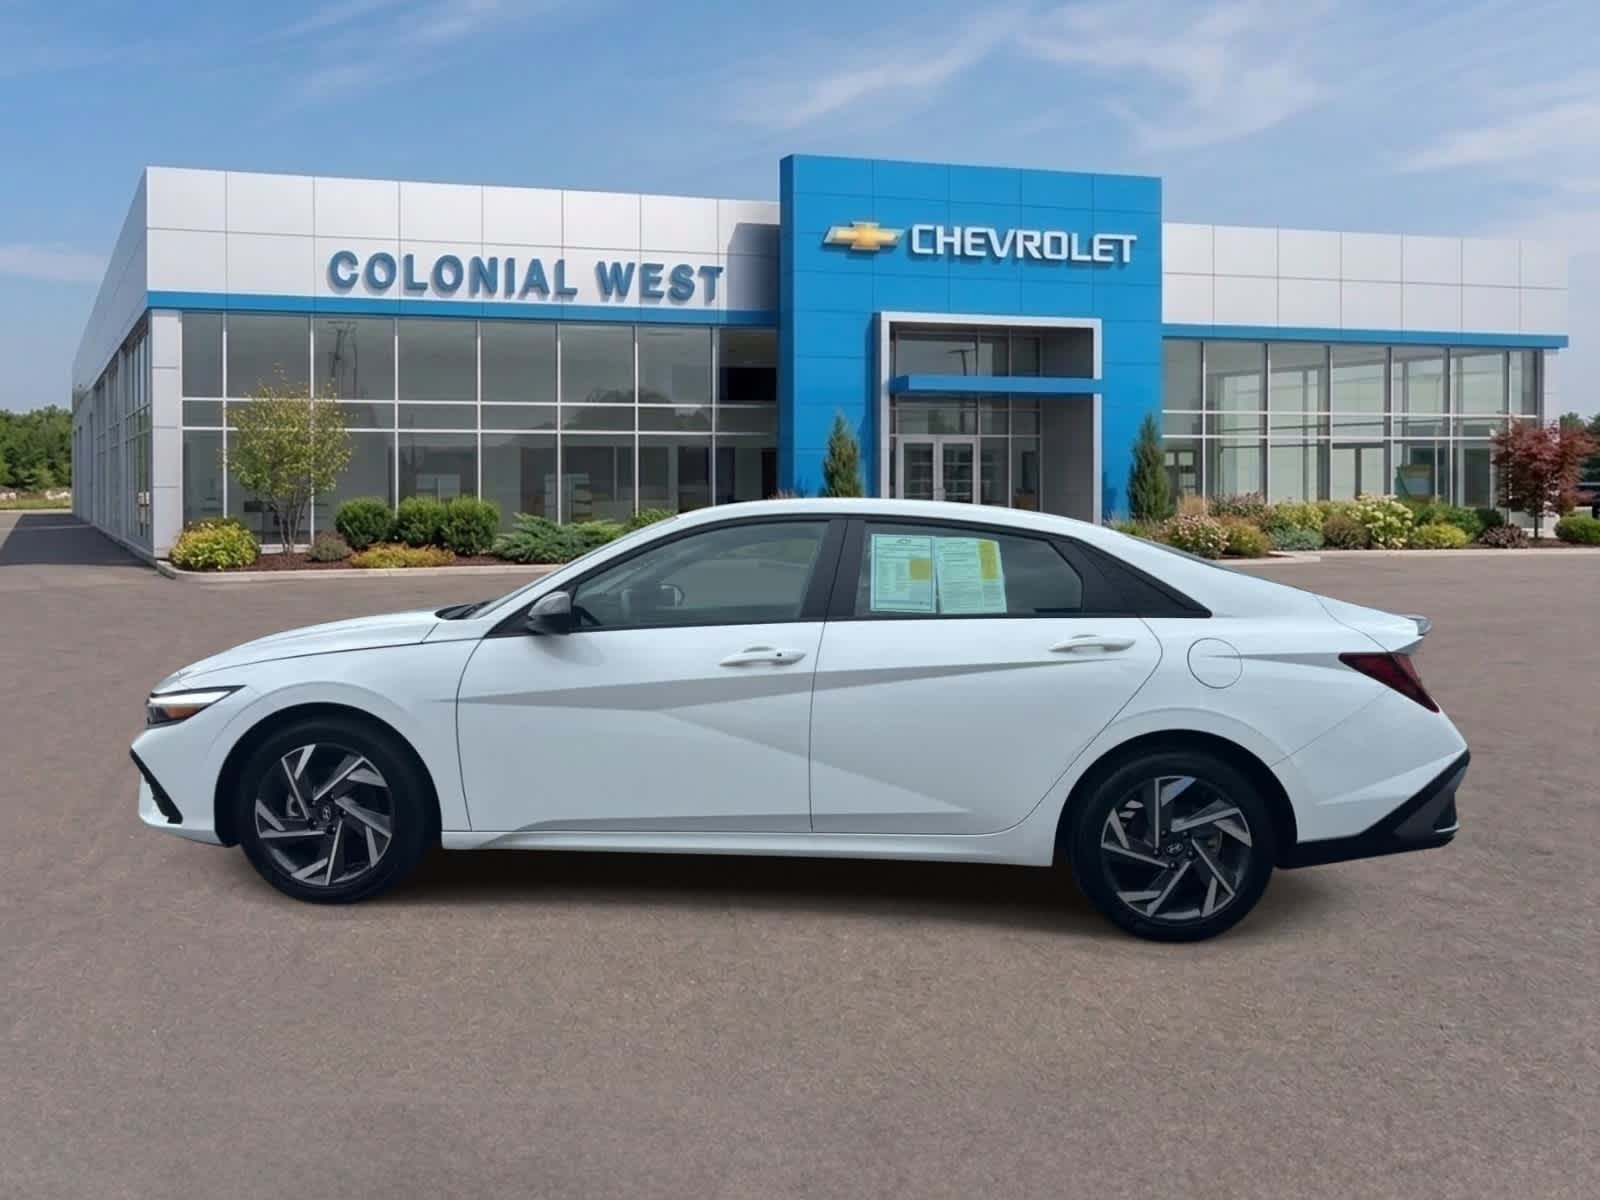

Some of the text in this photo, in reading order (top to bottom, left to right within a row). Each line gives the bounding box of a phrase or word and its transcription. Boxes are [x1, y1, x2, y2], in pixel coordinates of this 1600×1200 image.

[911, 223, 1138, 264] CHEVROLET
[328, 250, 724, 304] COLONIAL WEST
